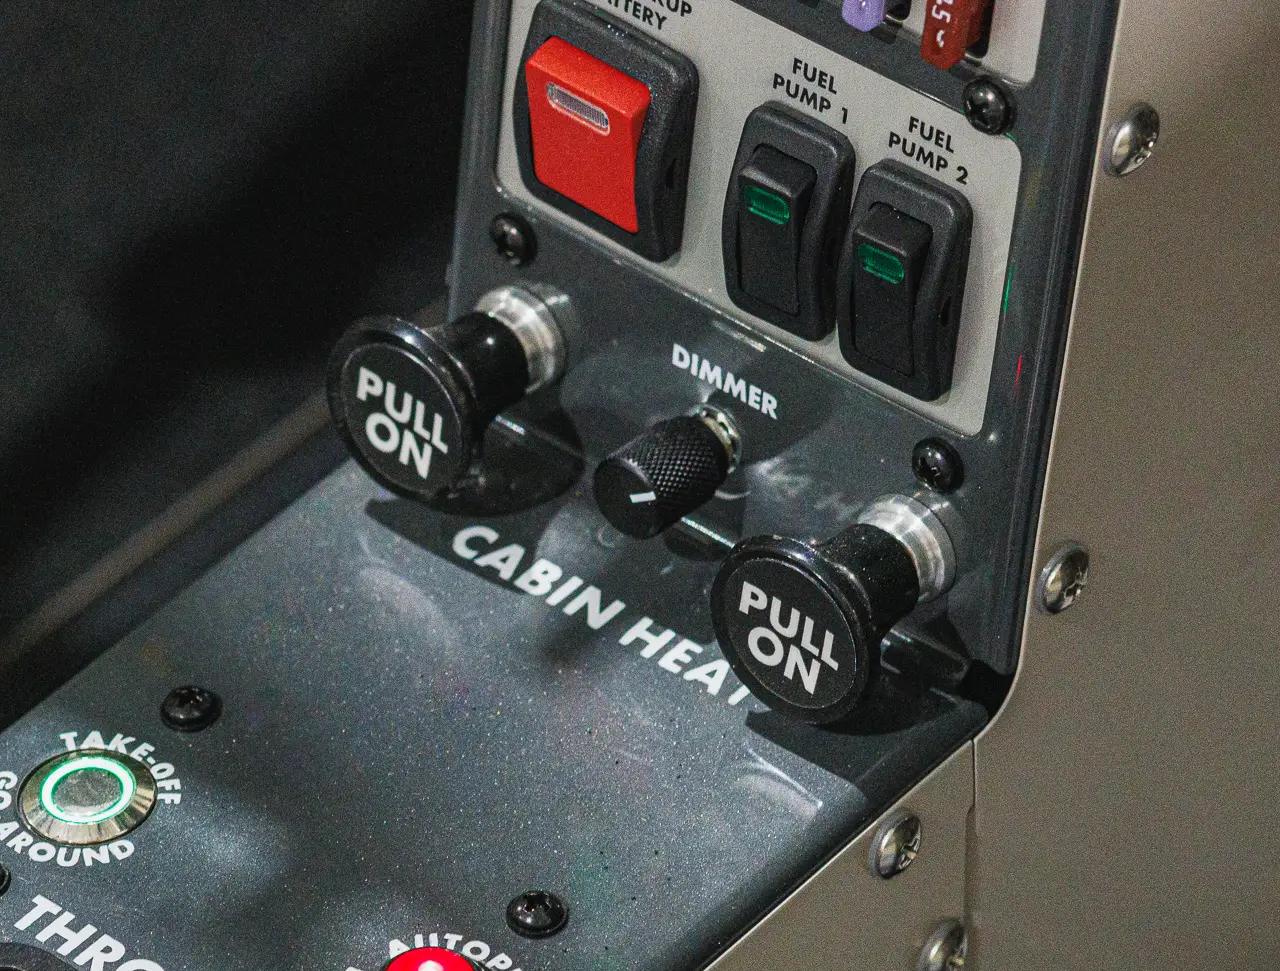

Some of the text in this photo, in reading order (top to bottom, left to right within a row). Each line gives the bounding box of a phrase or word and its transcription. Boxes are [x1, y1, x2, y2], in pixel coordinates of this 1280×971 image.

[772, 73, 849, 125] PUMP 1
[792, 57, 838, 95] FUEL
[888, 131, 969, 186] PUMP 2
[908, 116, 955, 155] FUEL
[356, 366, 449, 453] PULL
[671, 343, 779, 420] DIMMER
[364, 415, 433, 480] ON
[451, 524, 627, 631] CABIN
[738, 580, 840, 671] PULL
[747, 626, 821, 695] ON
[58, 730, 182, 805] TAKE-OFF
